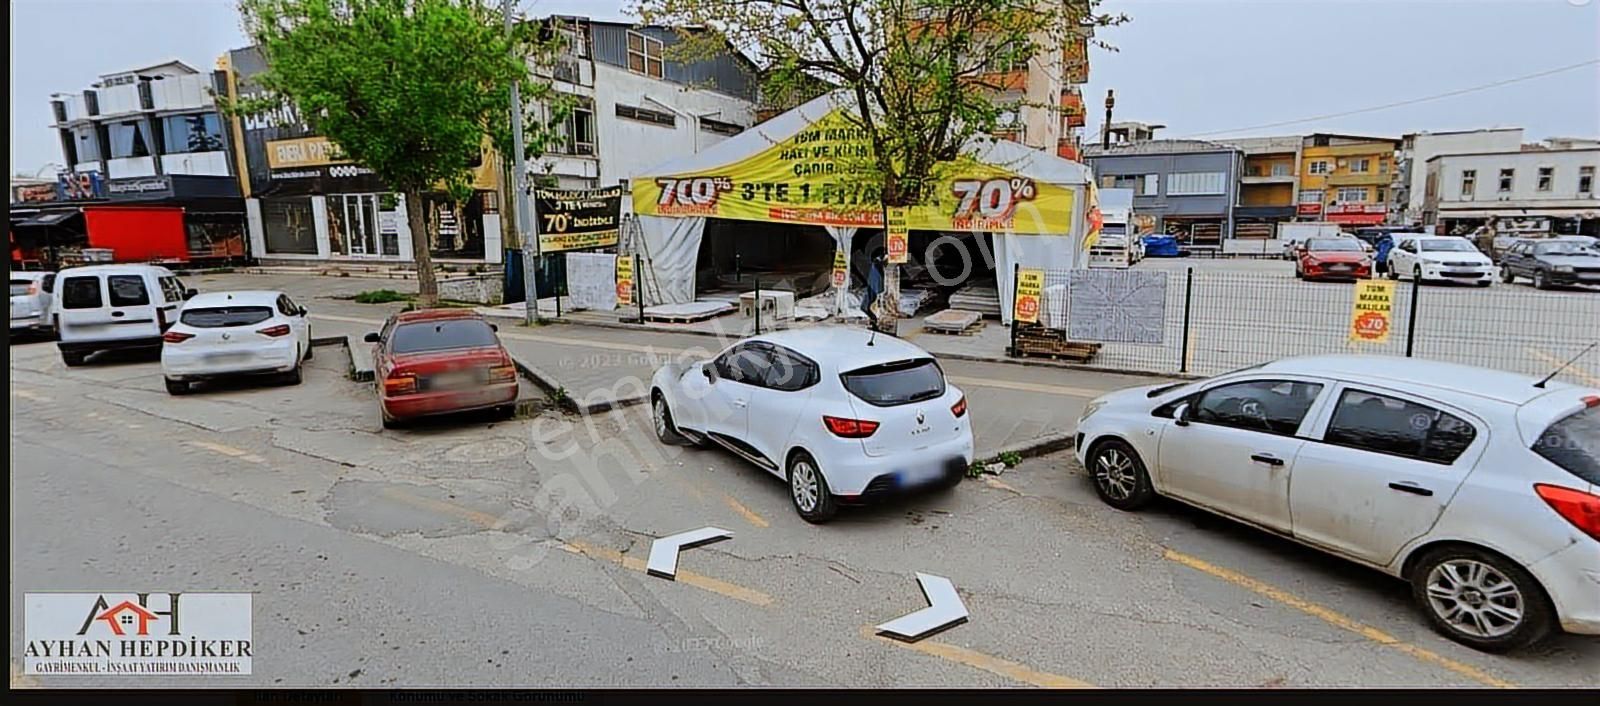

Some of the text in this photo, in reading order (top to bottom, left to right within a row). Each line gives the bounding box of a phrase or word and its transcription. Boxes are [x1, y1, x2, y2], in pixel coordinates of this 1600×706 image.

[813, 146, 830, 158] VE
[741, 182, 790, 202] 3'TE
[799, 183, 811, 202] 1
[953, 178, 1036, 219] 70%
